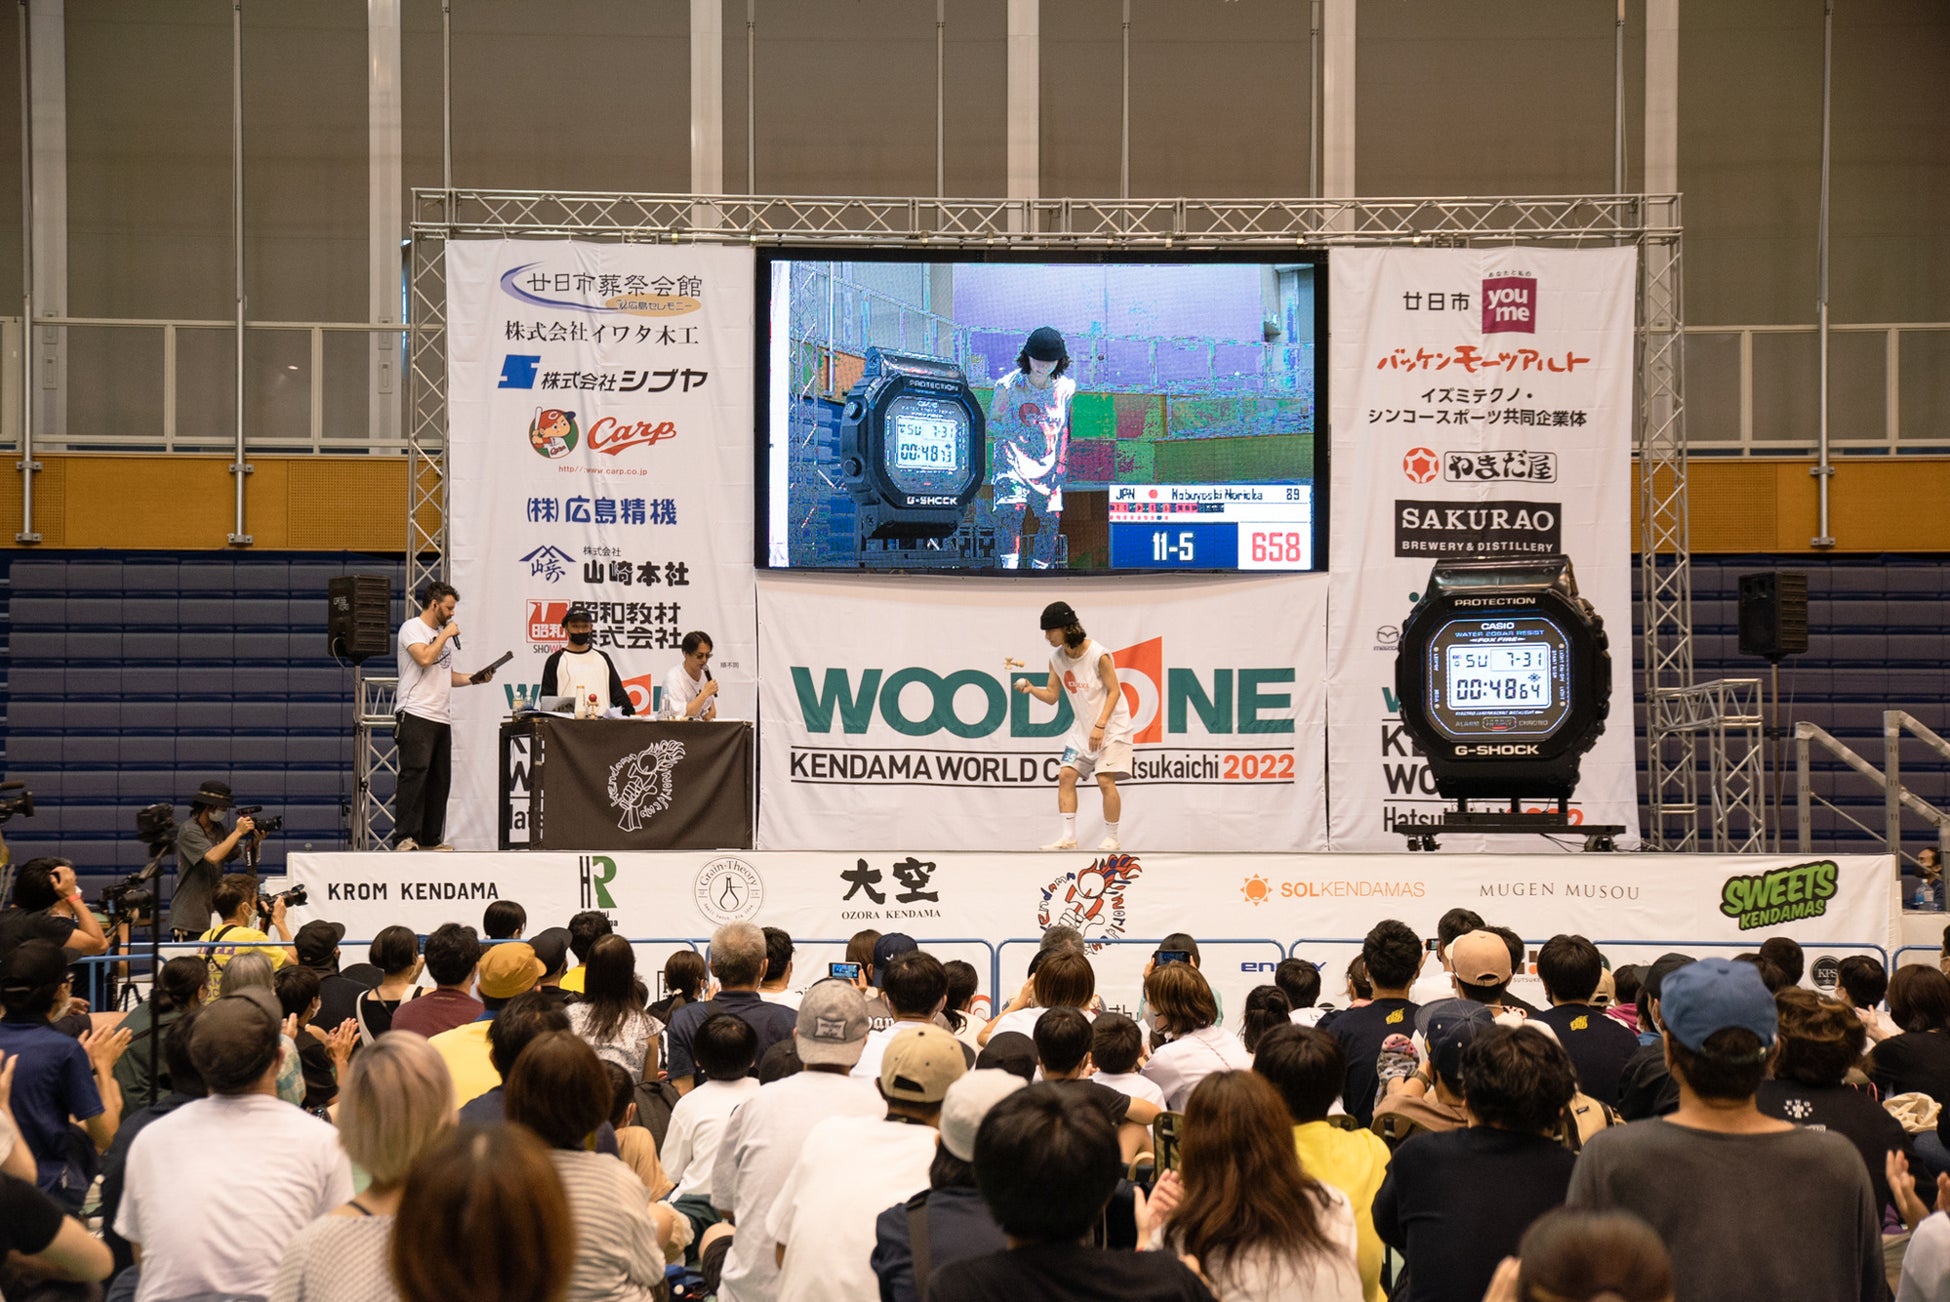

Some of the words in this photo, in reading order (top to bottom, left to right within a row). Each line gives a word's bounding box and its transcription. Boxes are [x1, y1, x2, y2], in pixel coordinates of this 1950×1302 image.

[526, 272, 703, 298] 廿日市葬祭会館
[1402, 291, 1470, 312] 廿日市
[1488, 287, 1529, 310] you
[1495, 304, 1530, 322] me
[505, 320, 699, 345] 株式会社イワタ木工
[1369, 408, 1588, 428] シンコースポーツ共同企業体
[587, 416, 678, 457] Carp
[1449, 450, 1553, 480] やまだ屋
[1402, 508, 1555, 531] SAKURAO
[583, 546, 622, 557] 株式会社
[1152, 531, 1194, 562] 11-5
[1252, 532, 1300, 562] 658
[1402, 541, 1463, 552] BREWERY
[1477, 541, 1553, 552] DISTILLERY
[1454, 597, 1536, 607] PROTECTION
[1481, 622, 1514, 630] CASIO
[588, 626, 682, 649] 式会社
[1507, 652, 1542, 667] 7-31
[1455, 745, 1539, 756] G-SHOCK
[791, 752, 933, 780] KENDAMA
[938, 755, 1043, 782] WORLD
[1131, 753, 1219, 780] tsukaichi
[1223, 754, 1294, 780] 2022
[328, 883, 388, 901] KROM
[400, 882, 499, 900] KENDAMA
[840, 857, 940, 905] 大空
[1479, 883, 1555, 897] MUGEN
[1565, 883, 1640, 900] MUSOU
[1723, 860, 1840, 915] SWEETS
[841, 911, 880, 920] OZORA
[886, 909, 941, 919] KENDAMA
[1741, 899, 1827, 928] KENDAMAS
